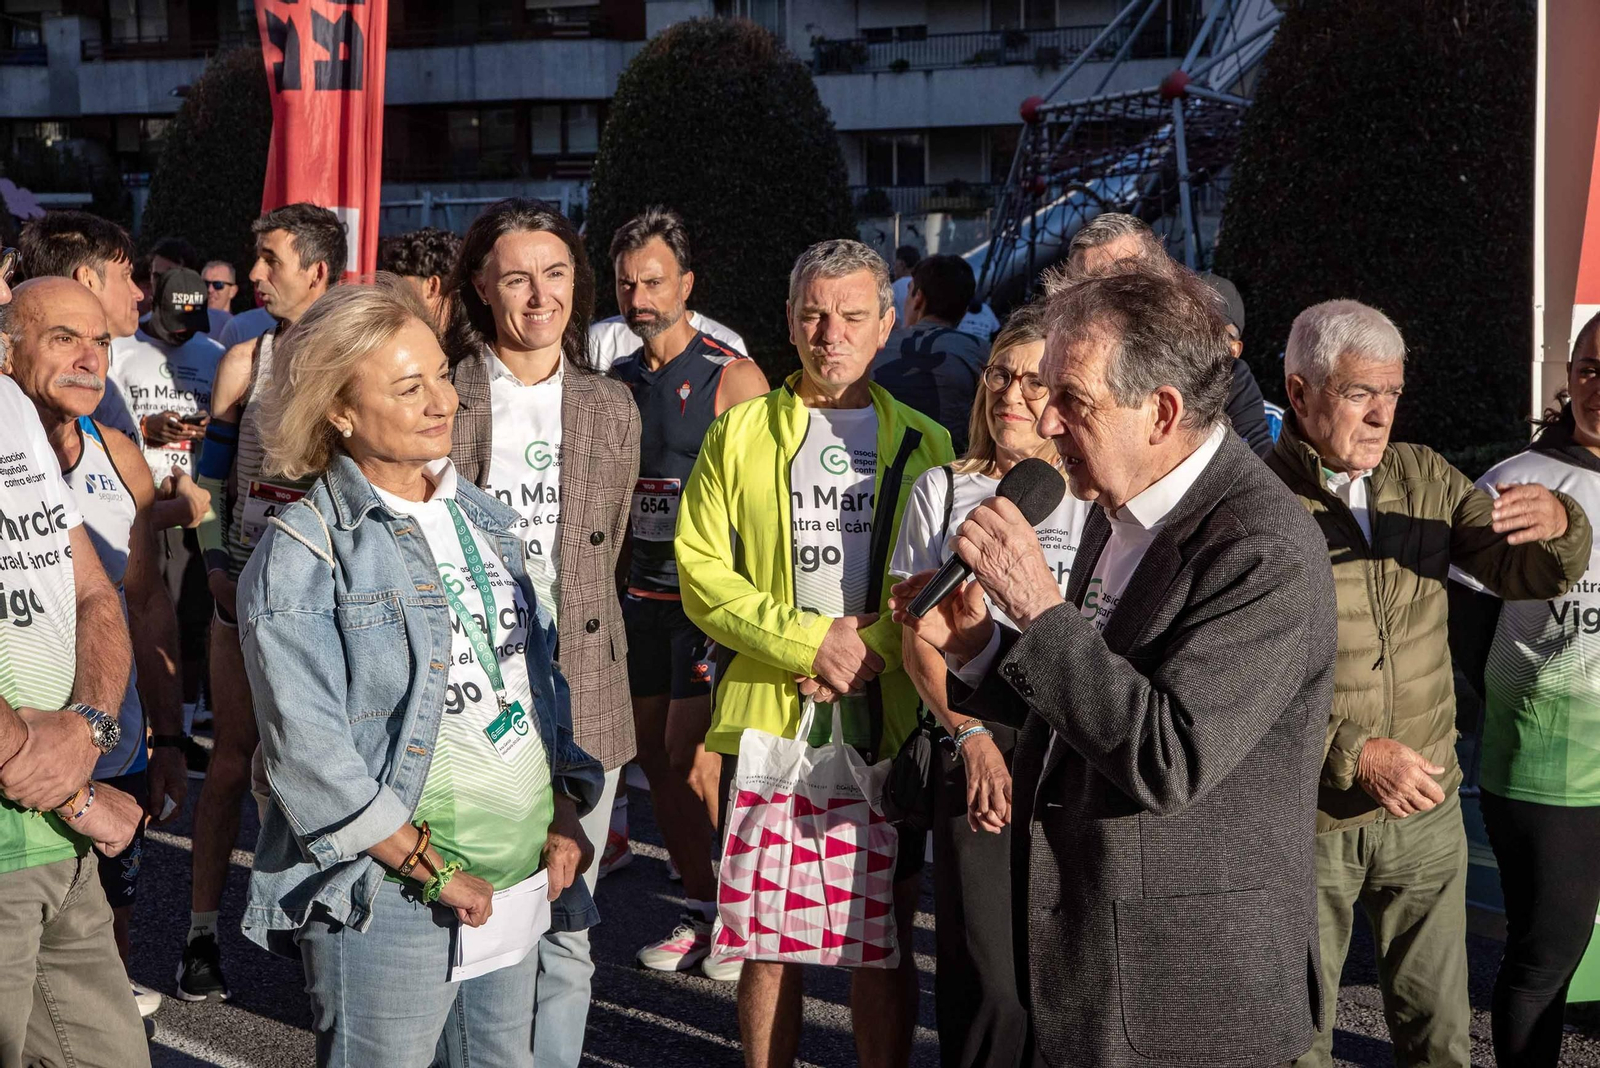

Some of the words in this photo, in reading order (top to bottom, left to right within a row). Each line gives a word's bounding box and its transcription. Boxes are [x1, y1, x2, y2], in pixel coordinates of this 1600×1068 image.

[129, 385, 149, 399] En
[171, 404, 196, 413] cánce
[641, 497, 670, 514] 654
[792, 491, 803, 509] n
[826, 520, 841, 532] el
[845, 519, 872, 533] cán
[1035, 528, 1068, 536] ociación
[793, 539, 841, 573] igo
[0, 582, 45, 627] igo
[1547, 600, 1600, 634] Vig
[459, 648, 474, 664] el
[445, 681, 482, 714] go
